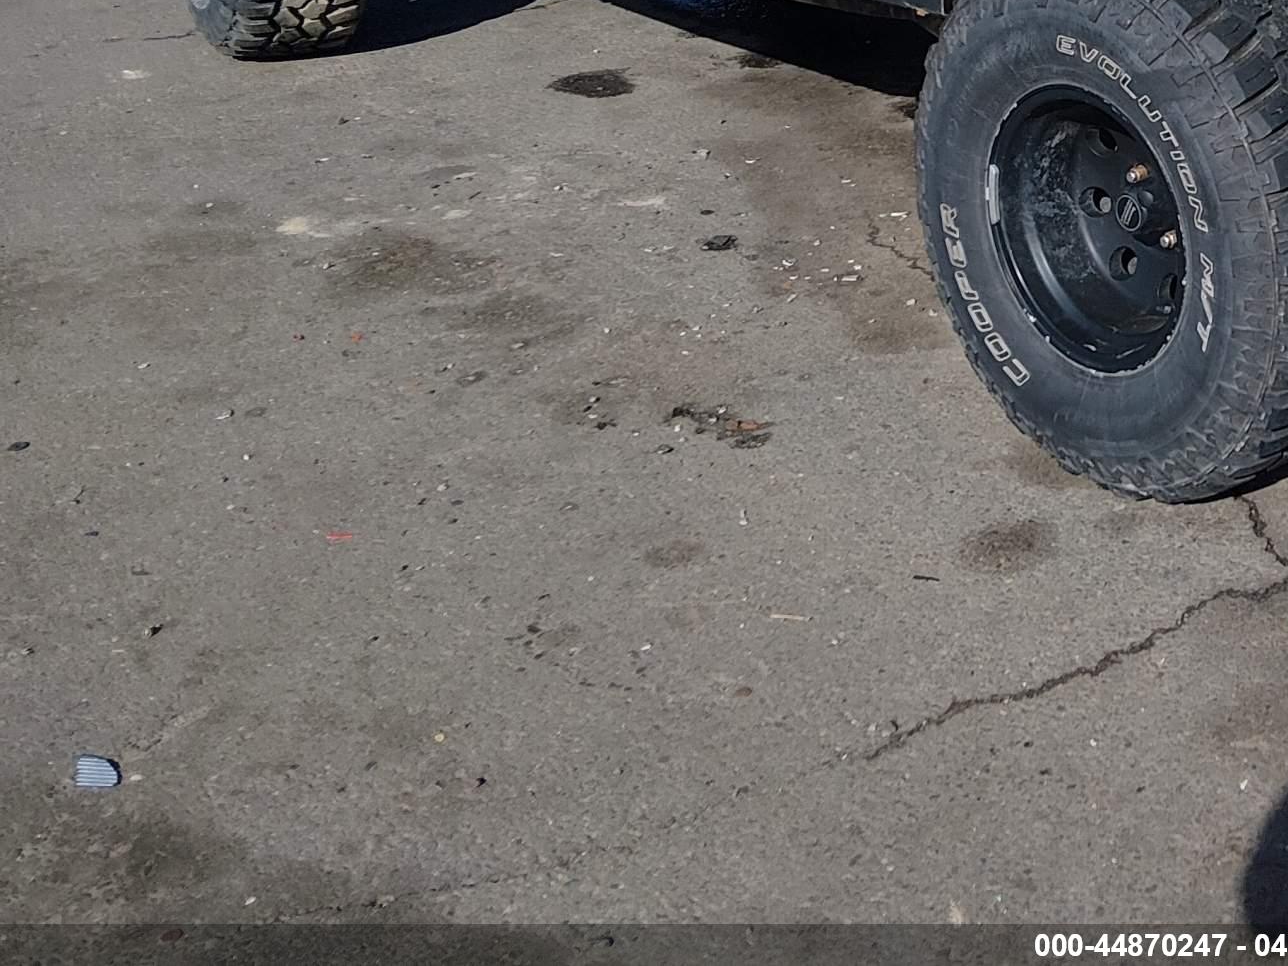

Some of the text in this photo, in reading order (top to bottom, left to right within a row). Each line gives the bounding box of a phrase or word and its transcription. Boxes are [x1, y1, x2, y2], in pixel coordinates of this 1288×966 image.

[940, 203, 1030, 386] COOPER
[1056, 34, 1215, 353] EVOLUTION M/T
